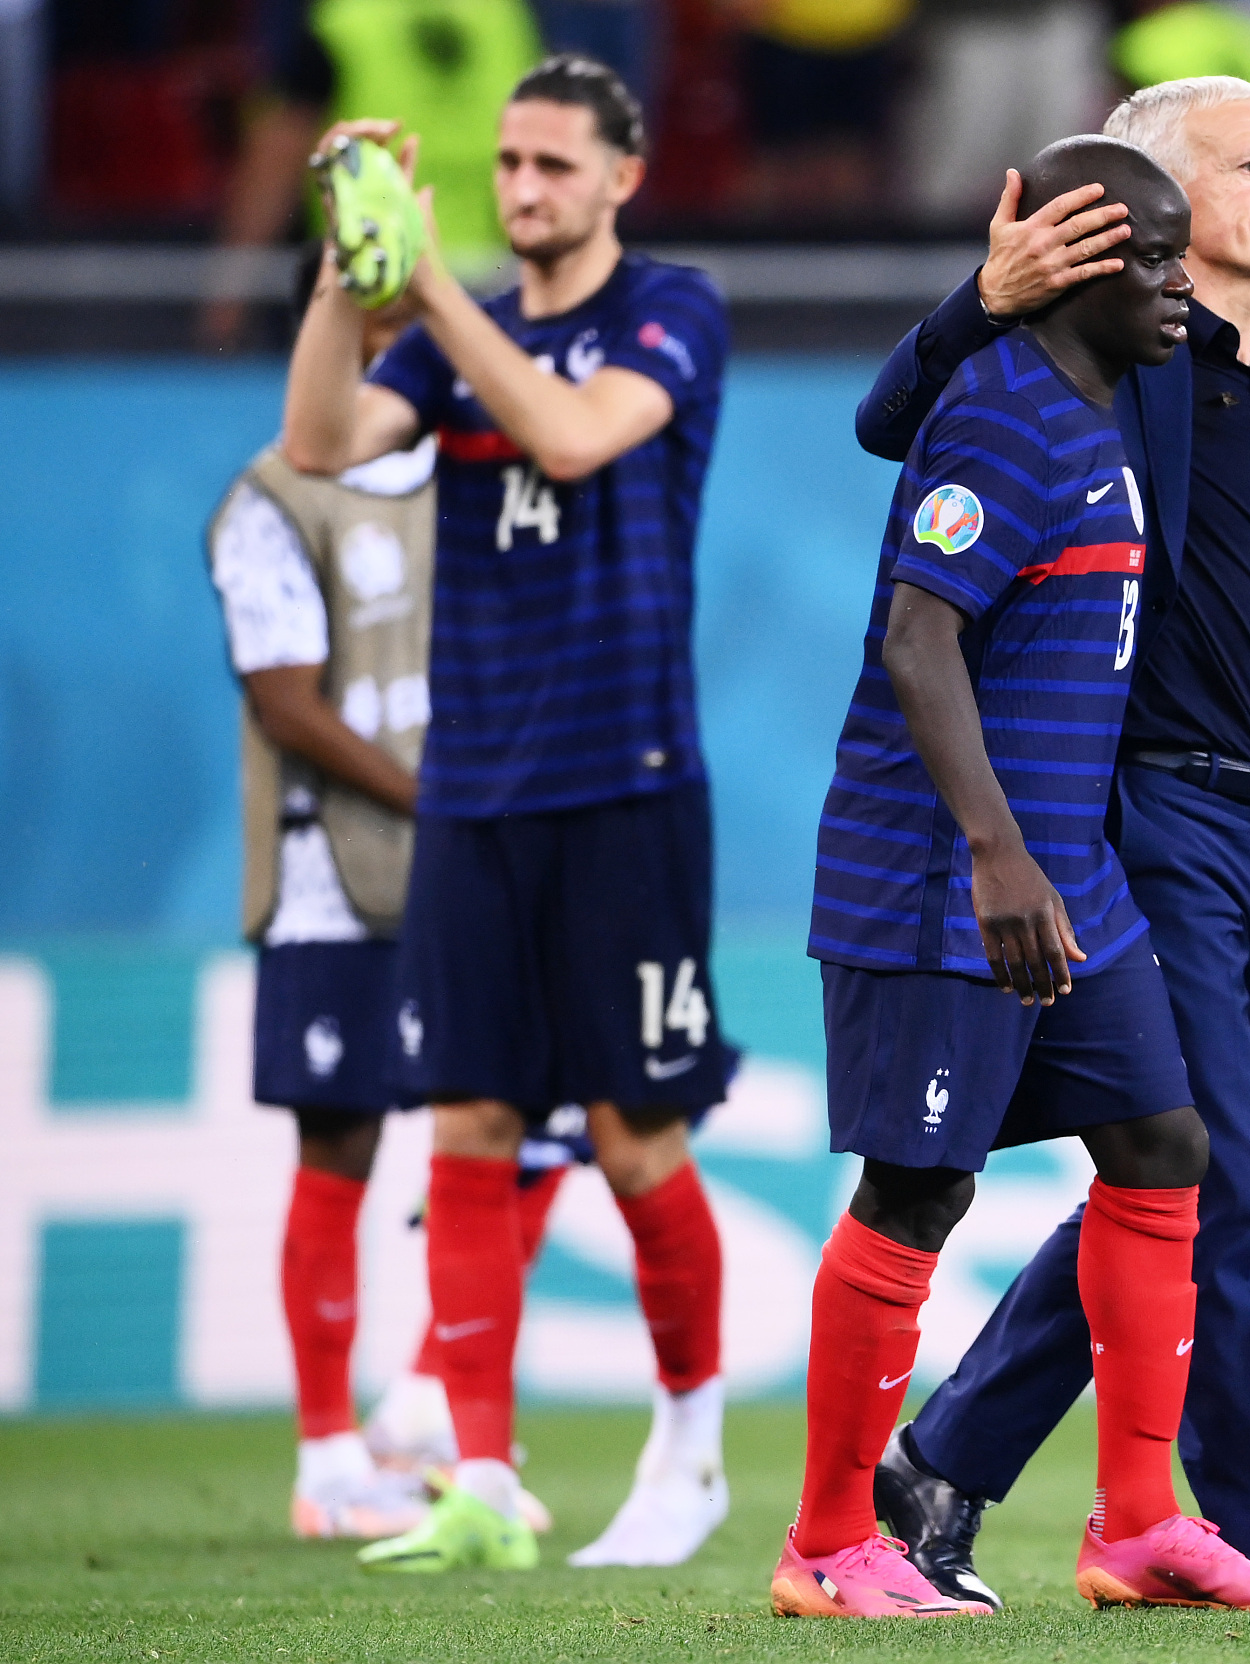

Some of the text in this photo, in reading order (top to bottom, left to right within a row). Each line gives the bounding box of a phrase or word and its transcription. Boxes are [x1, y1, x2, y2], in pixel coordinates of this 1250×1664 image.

[496, 466, 561, 551] 14
[1114, 579, 1139, 671] 13
[637, 957, 711, 1048] 14
